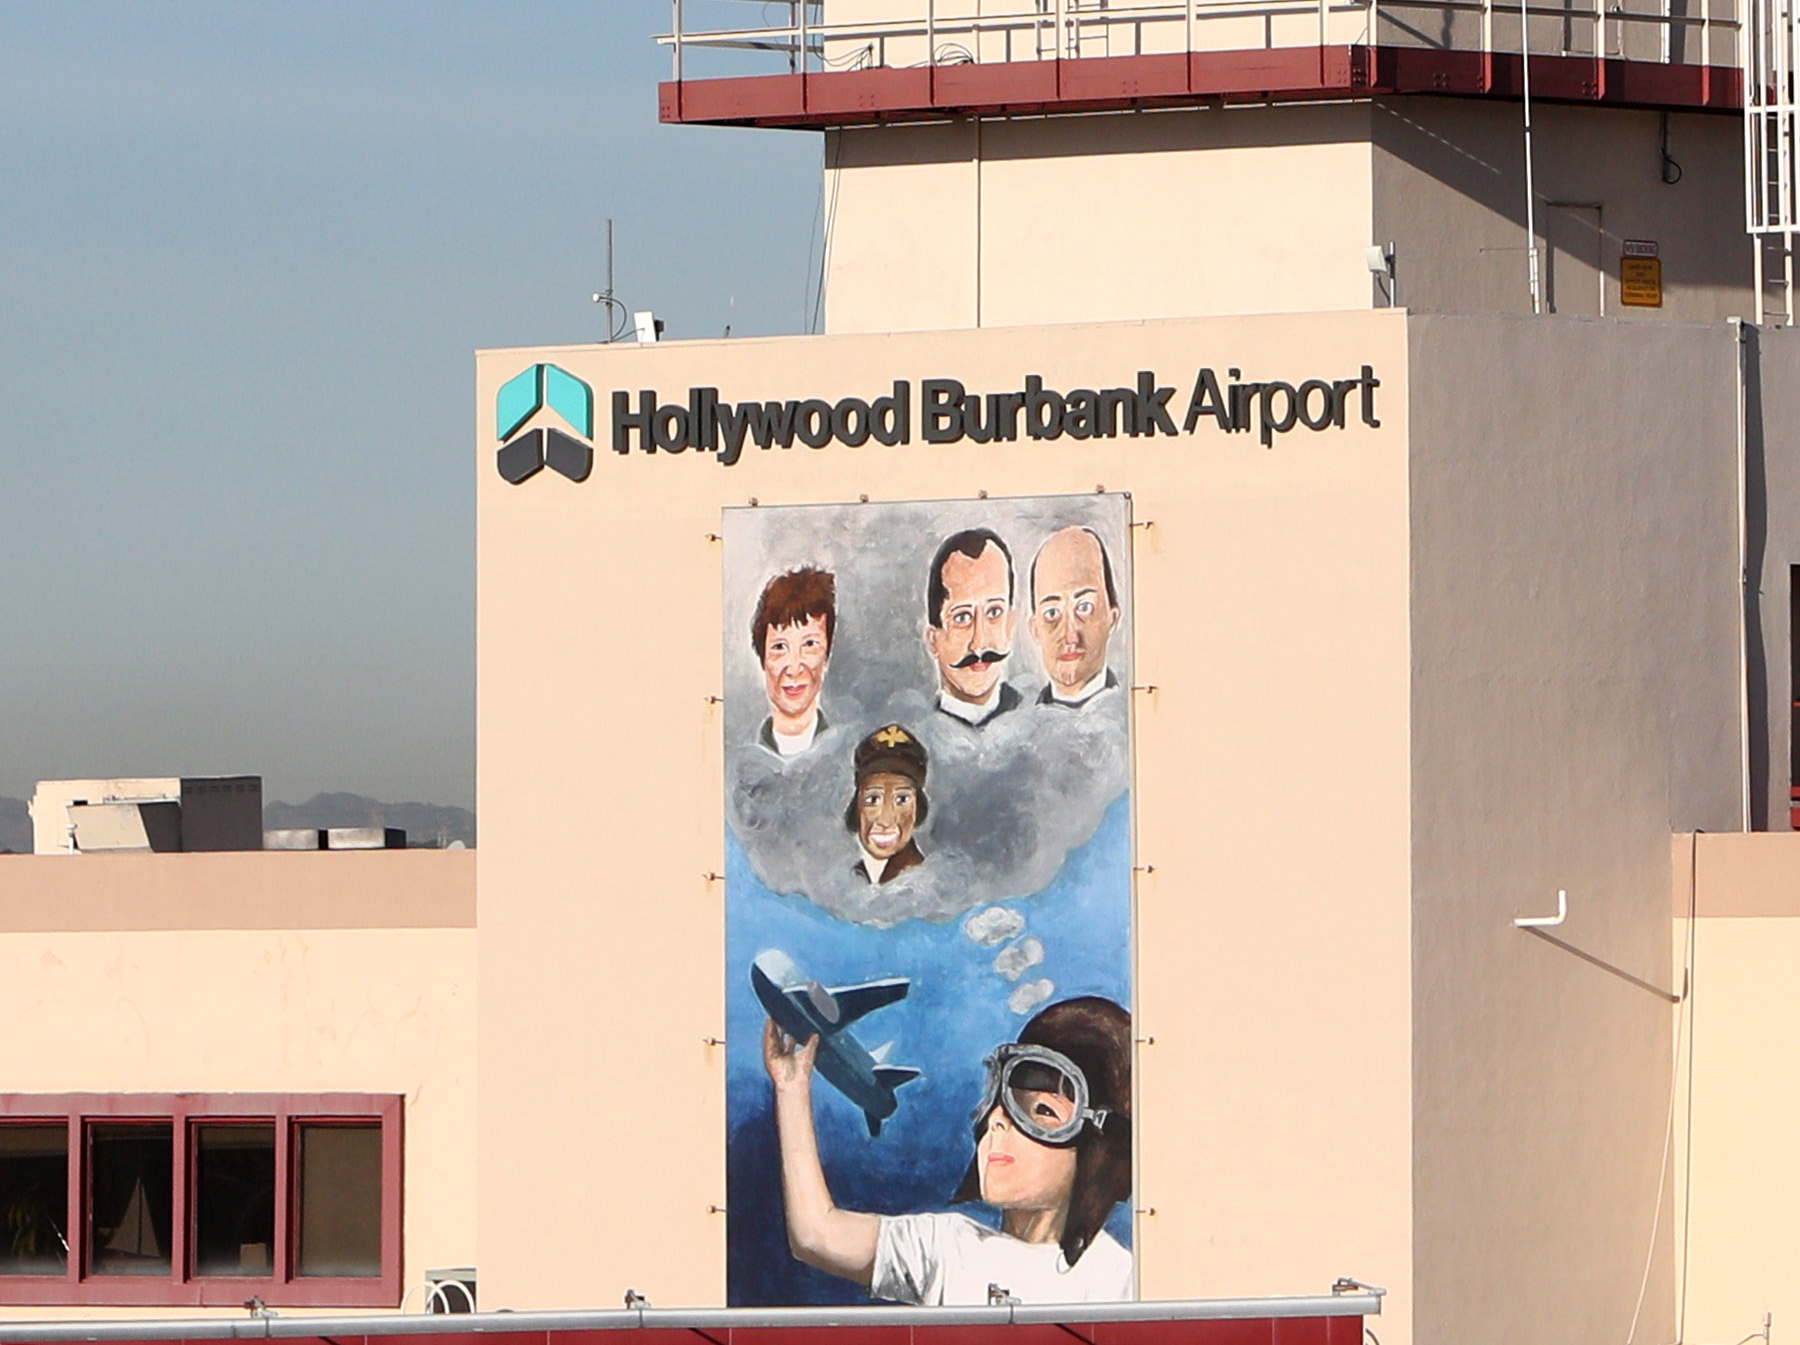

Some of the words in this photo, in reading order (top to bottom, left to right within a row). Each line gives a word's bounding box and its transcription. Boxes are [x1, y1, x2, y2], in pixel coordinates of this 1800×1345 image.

[611, 380, 911, 466] Hollywood
[921, 370, 1178, 444] Burbank
[1182, 364, 1380, 449] Airport
